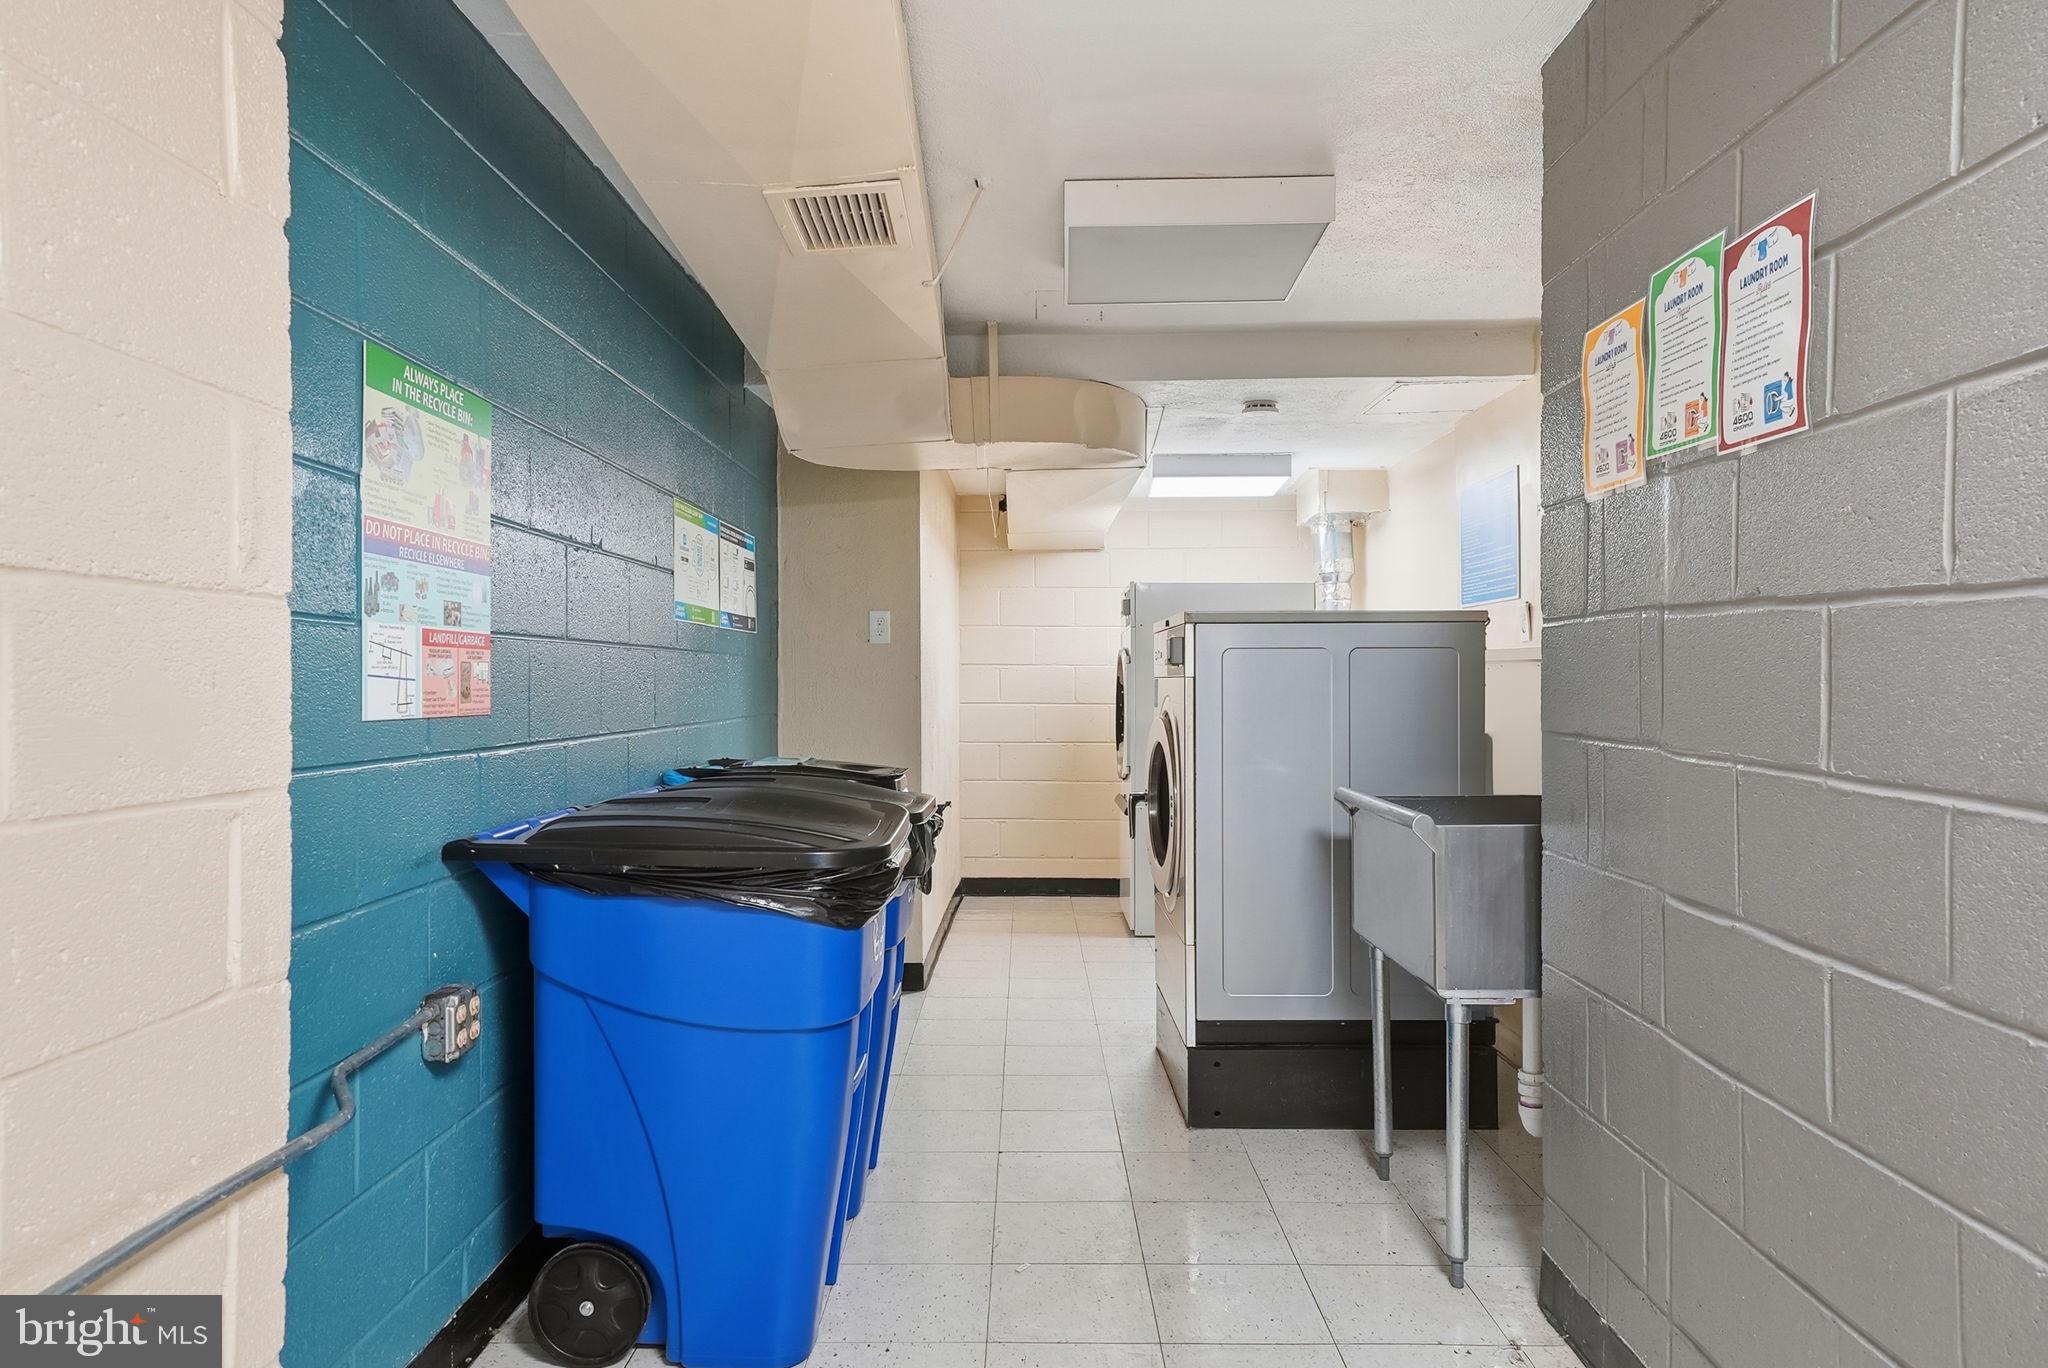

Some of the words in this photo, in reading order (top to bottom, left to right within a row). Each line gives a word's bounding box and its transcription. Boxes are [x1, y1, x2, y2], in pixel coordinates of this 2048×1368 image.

[1740, 264, 1769, 290] LAUNDRY
[1769, 253, 1789, 275] ROOM
[1664, 291, 1687, 313] LAUNDRY
[1687, 282, 1704, 300] ROOM
[1594, 348, 1614, 367] LAUNDRY
[1614, 340, 1628, 357] ROOM
[392, 377, 402, 395] IN
[403, 382, 422, 404] THE
[422, 391, 456, 419] RECYCLE
[457, 408, 474, 427] BIN:
[403, 364, 439, 394] ALWAYS
[440, 382, 465, 407] PLACE
[1733, 410, 1754, 426] 4600
[365, 519, 381, 537] DO
[382, 523, 403, 542] NOT
[404, 528, 430, 548] PLACE
[431, 535, 441, 551] IN
[442, 537, 475, 559] RECYCLE
[398, 545, 428, 564] RECYCLE
[428, 551, 465, 570] ELSEWHERE
